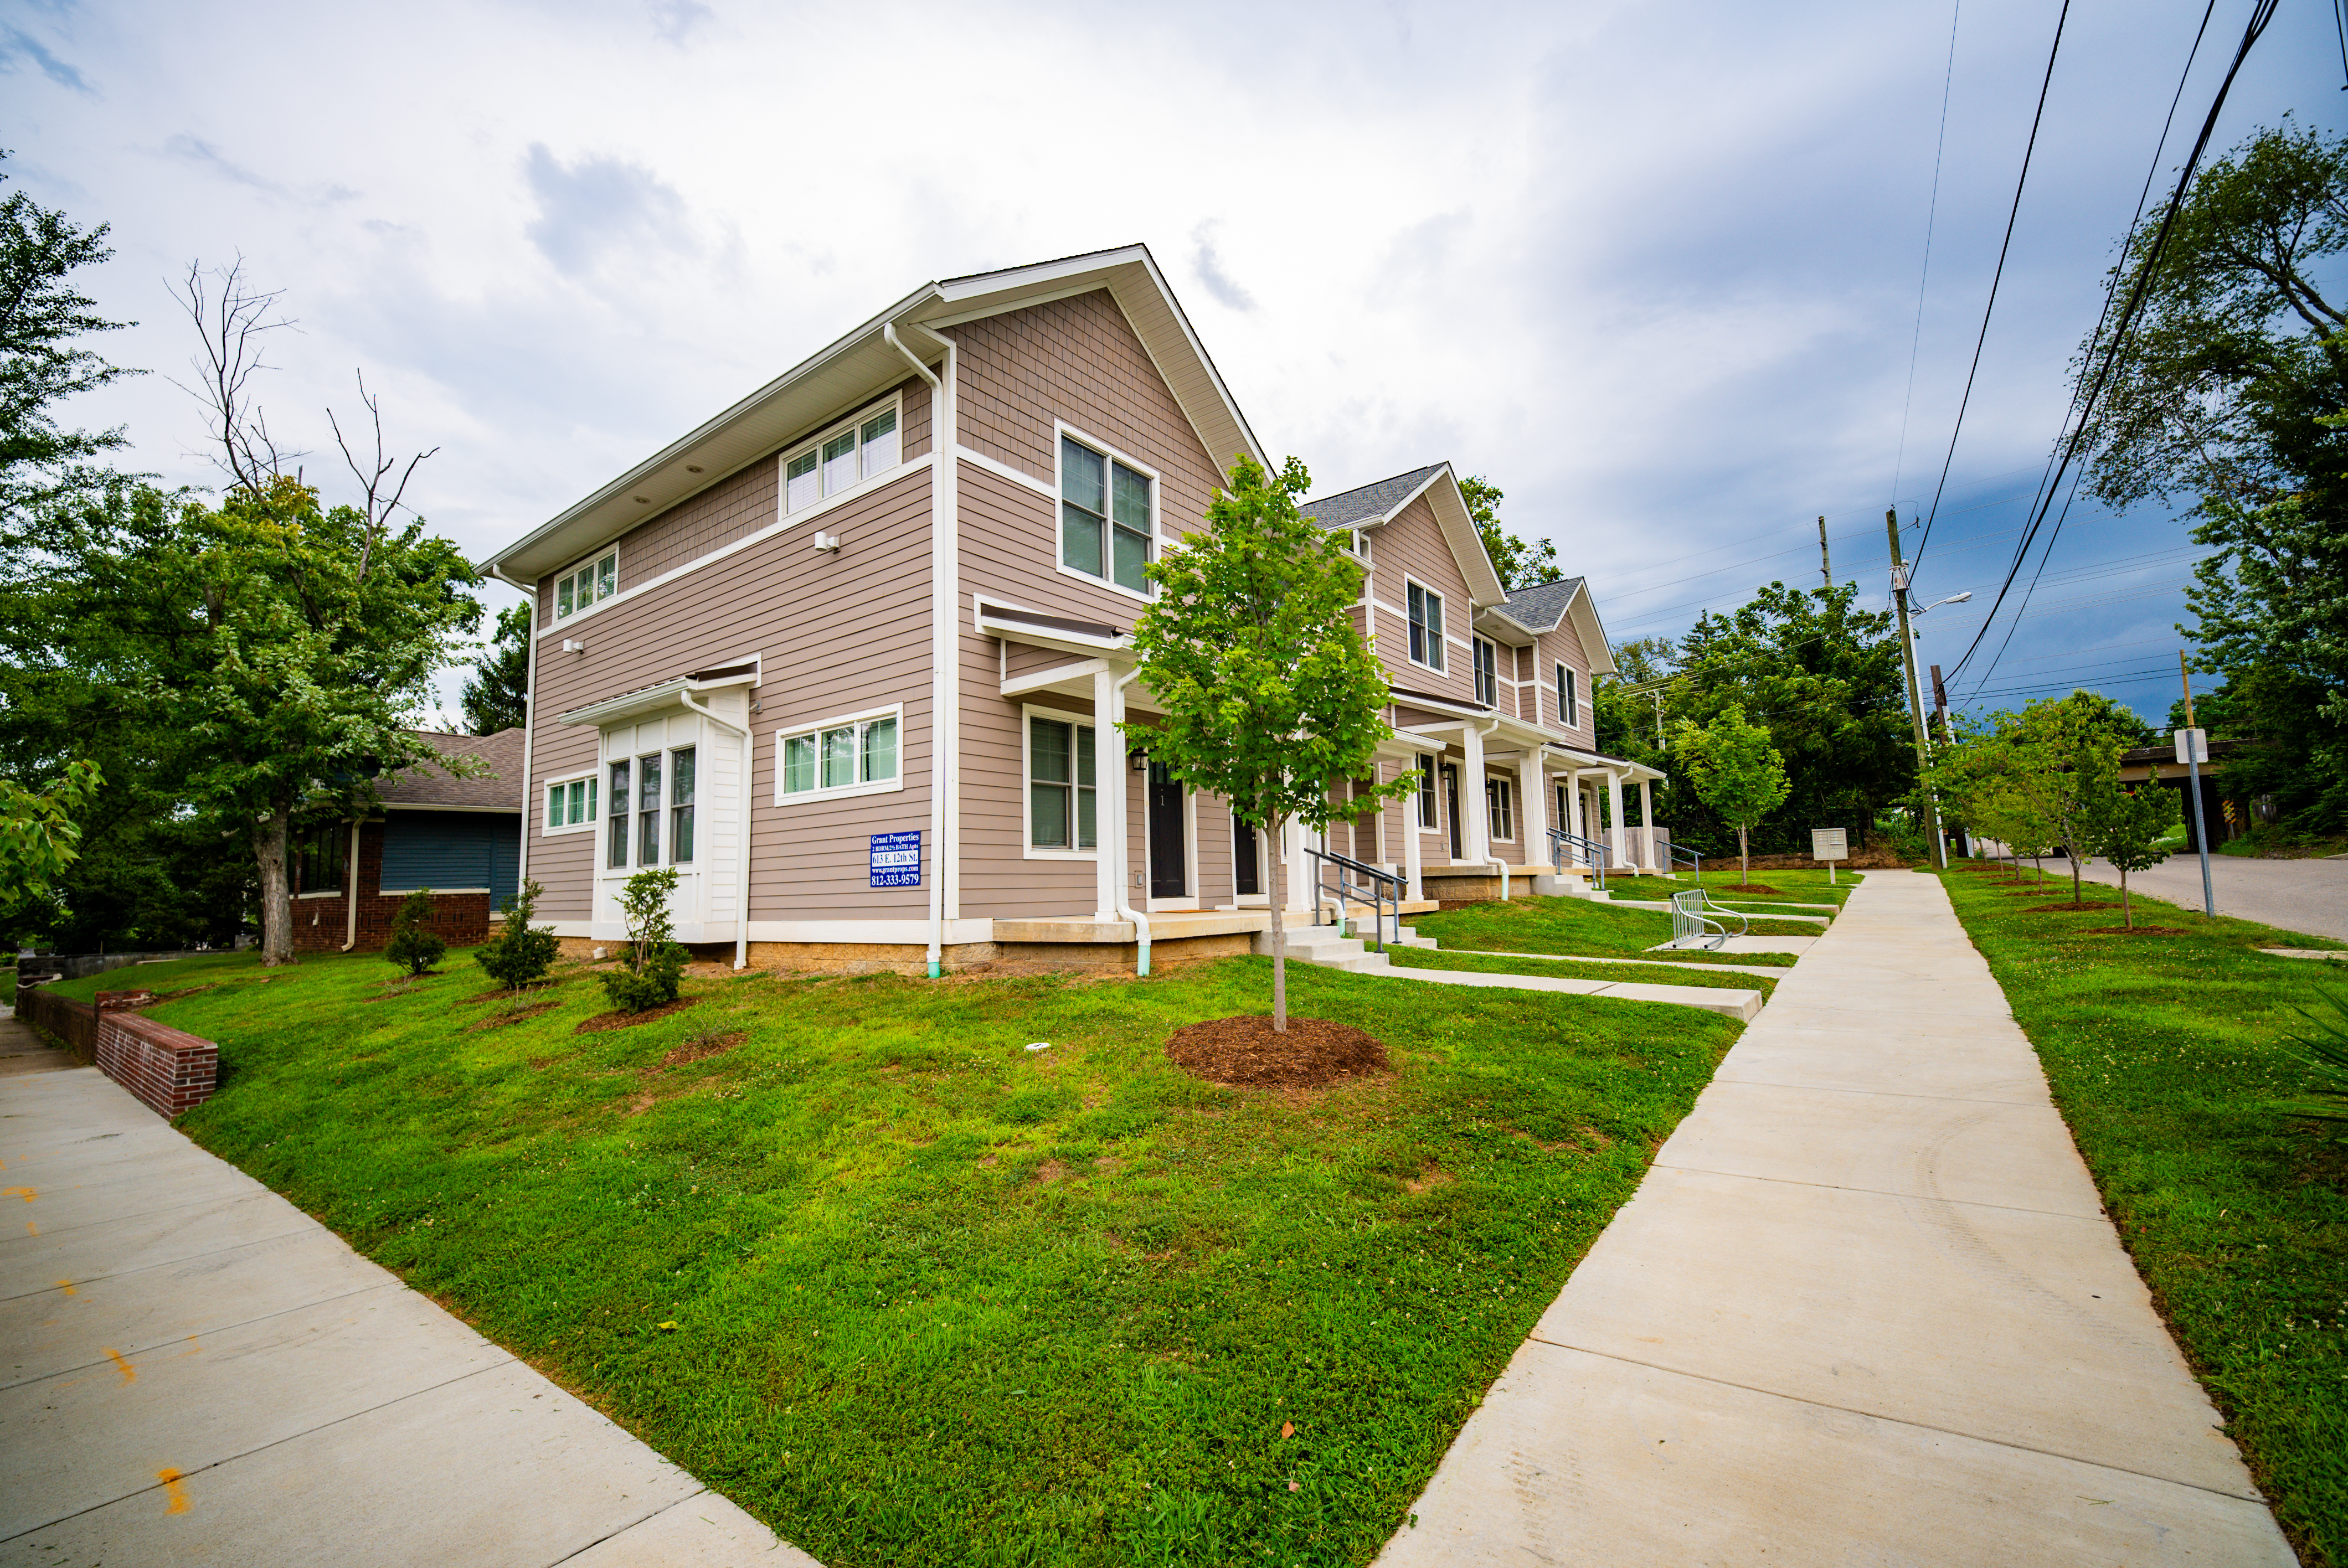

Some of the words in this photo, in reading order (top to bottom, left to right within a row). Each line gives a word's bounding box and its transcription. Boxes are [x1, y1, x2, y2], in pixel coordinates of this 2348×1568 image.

[1160, 795, 1165, 806] 1
[872, 835, 888, 844] Grant
[889, 833, 919, 844] Properties
[873, 854, 883, 864] 613
[885, 854, 891, 863] E.
[894, 853, 907, 863] 12th
[909, 852, 918, 862] St.
[872, 866, 918, 874] www.grantprops.com
[872, 874, 919, 886] 812-333-9579
